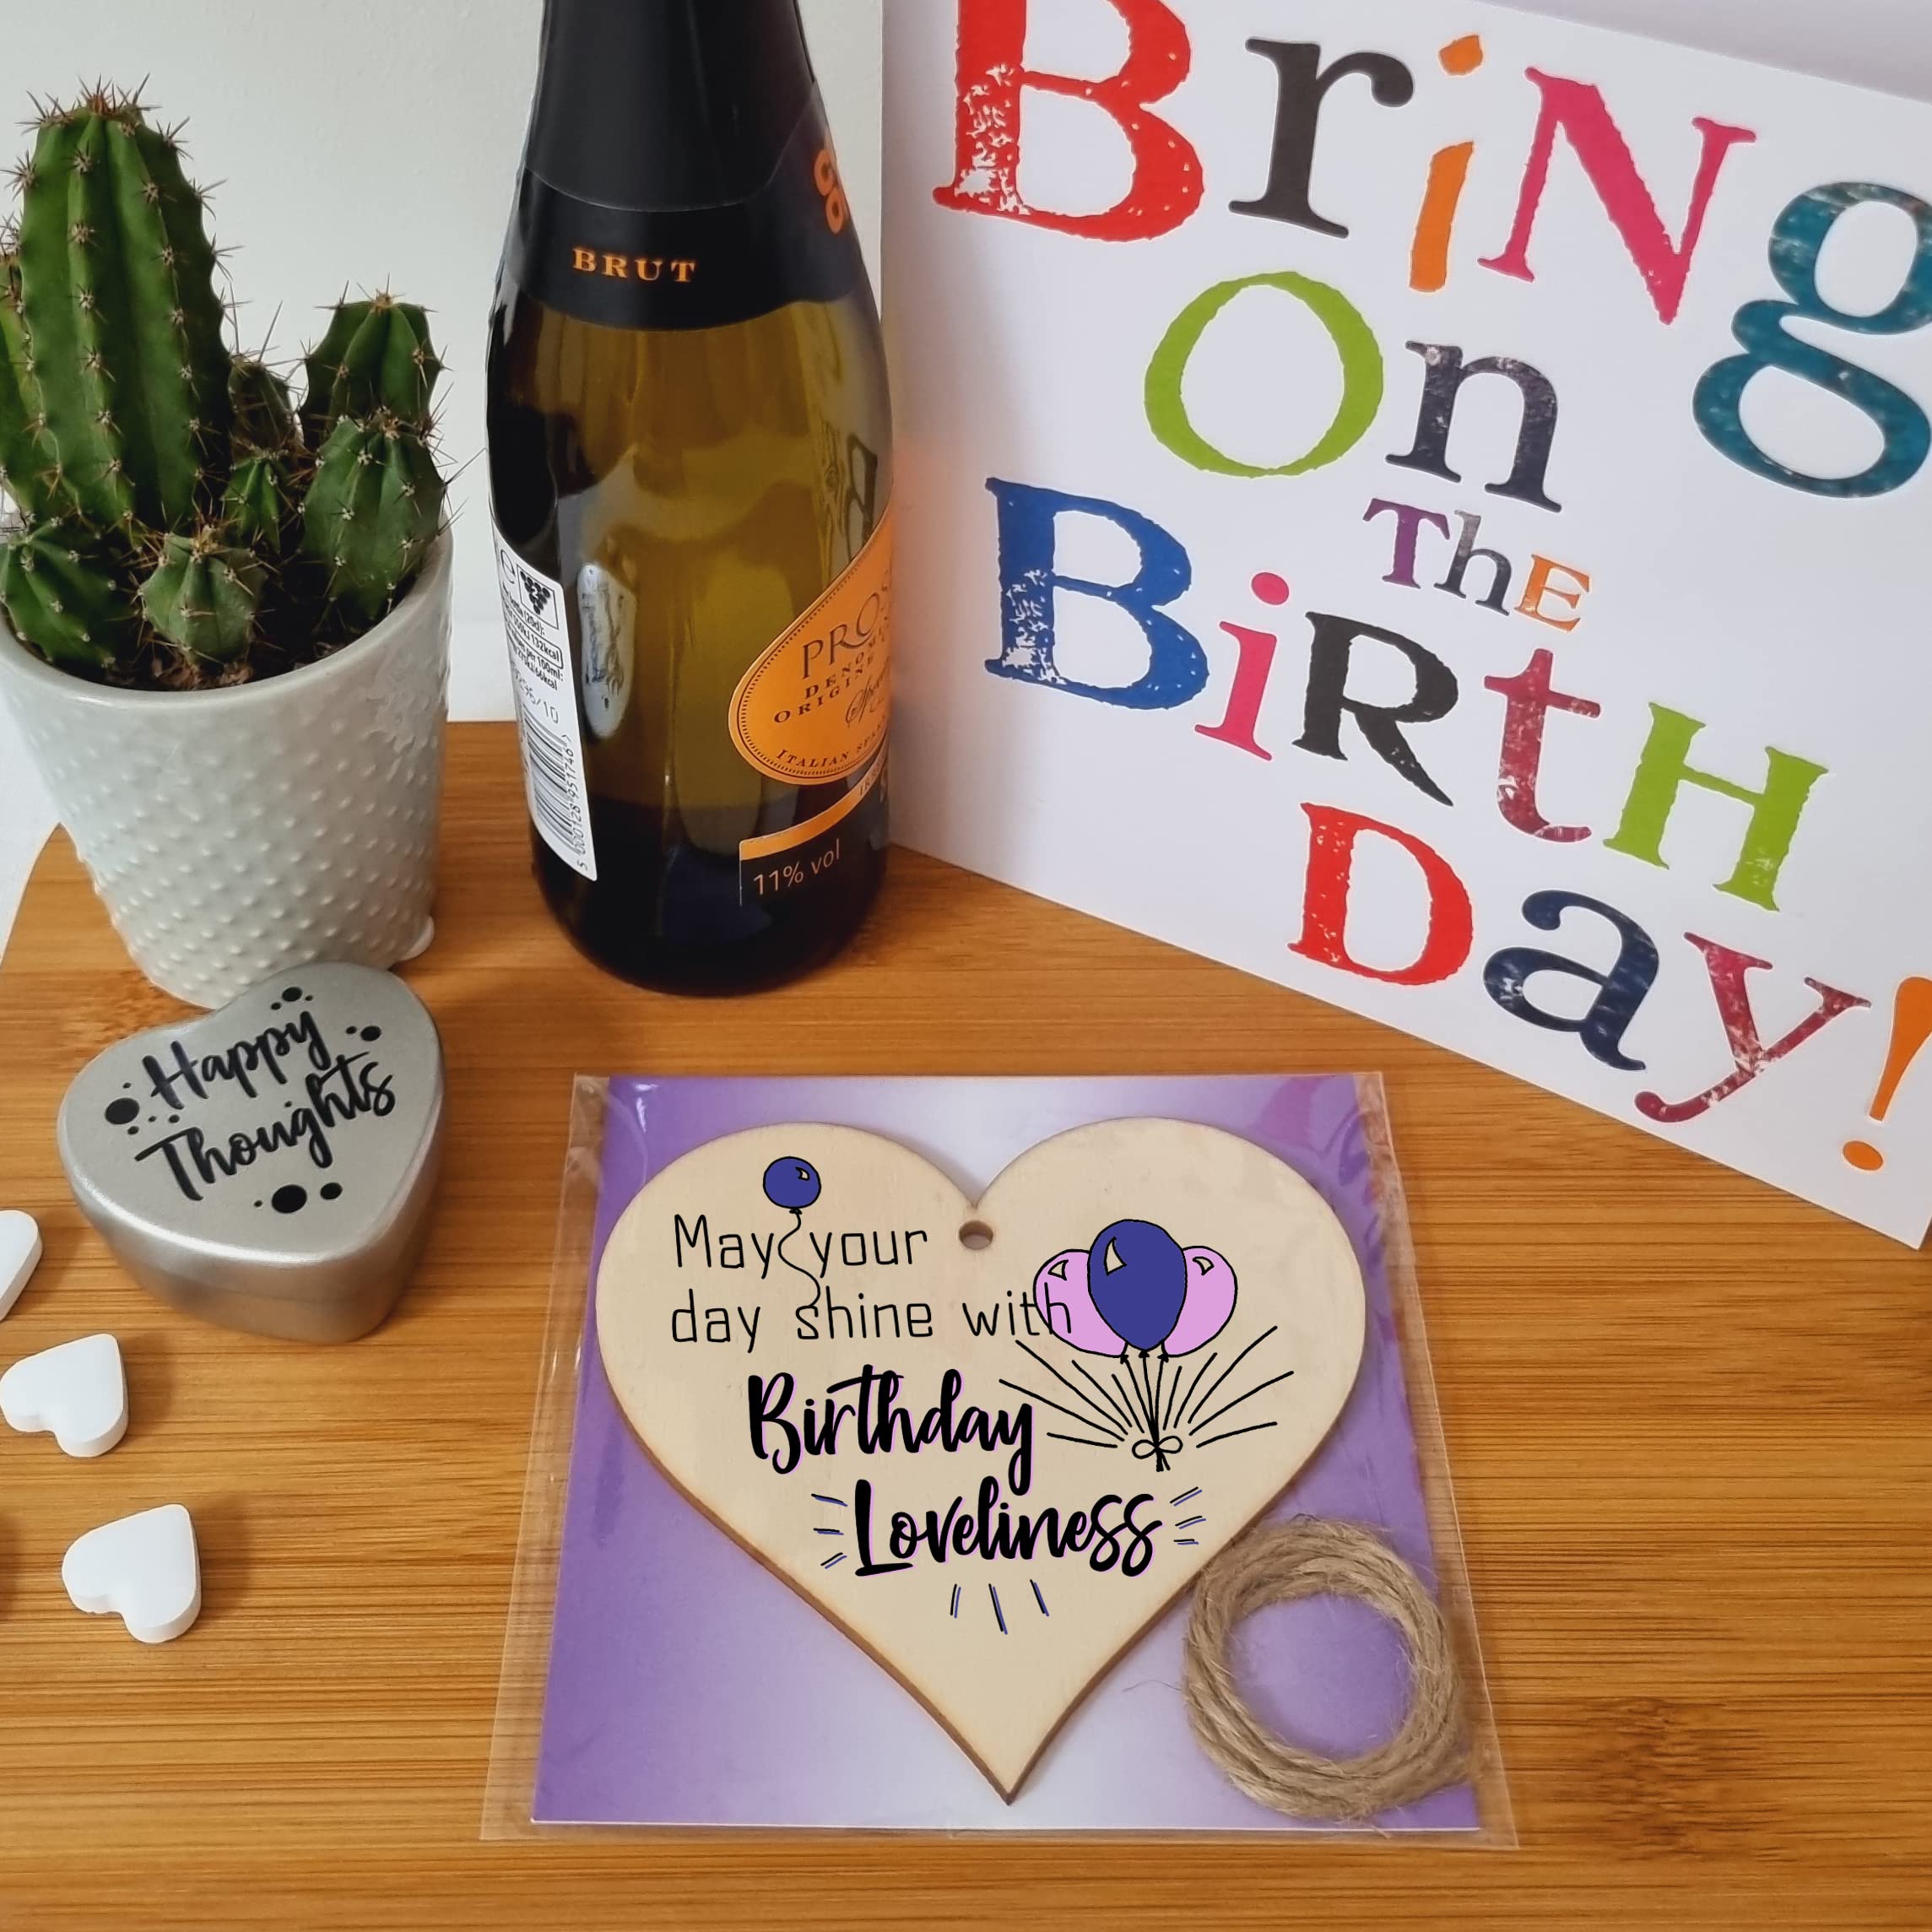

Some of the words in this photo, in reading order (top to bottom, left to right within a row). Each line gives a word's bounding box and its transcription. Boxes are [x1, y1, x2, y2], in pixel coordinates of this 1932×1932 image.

[572, 246, 695, 283] BRUT
[932, 0, 1932, 499] BriNg
[1144, 271, 1562, 513] On
[1361, 496, 1591, 633] ThE
[985, 477, 1829, 912] BiRtH
[777, 750, 849, 767] ITALIAN
[754, 861, 804, 895] 11%
[811, 838, 840, 874] vol
[142, 1011, 332, 1110] Happy
[134, 1052, 396, 1201] Thoughts
[674, 1214, 773, 1278] May
[809, 1228, 927, 1278] your
[672, 1289, 761, 1353] day
[795, 1289, 933, 1339] shine
[962, 1282, 1072, 1337] with
[748, 1364, 1035, 1495] Birthday
[854, 1475, 1163, 1578] Loveliness
